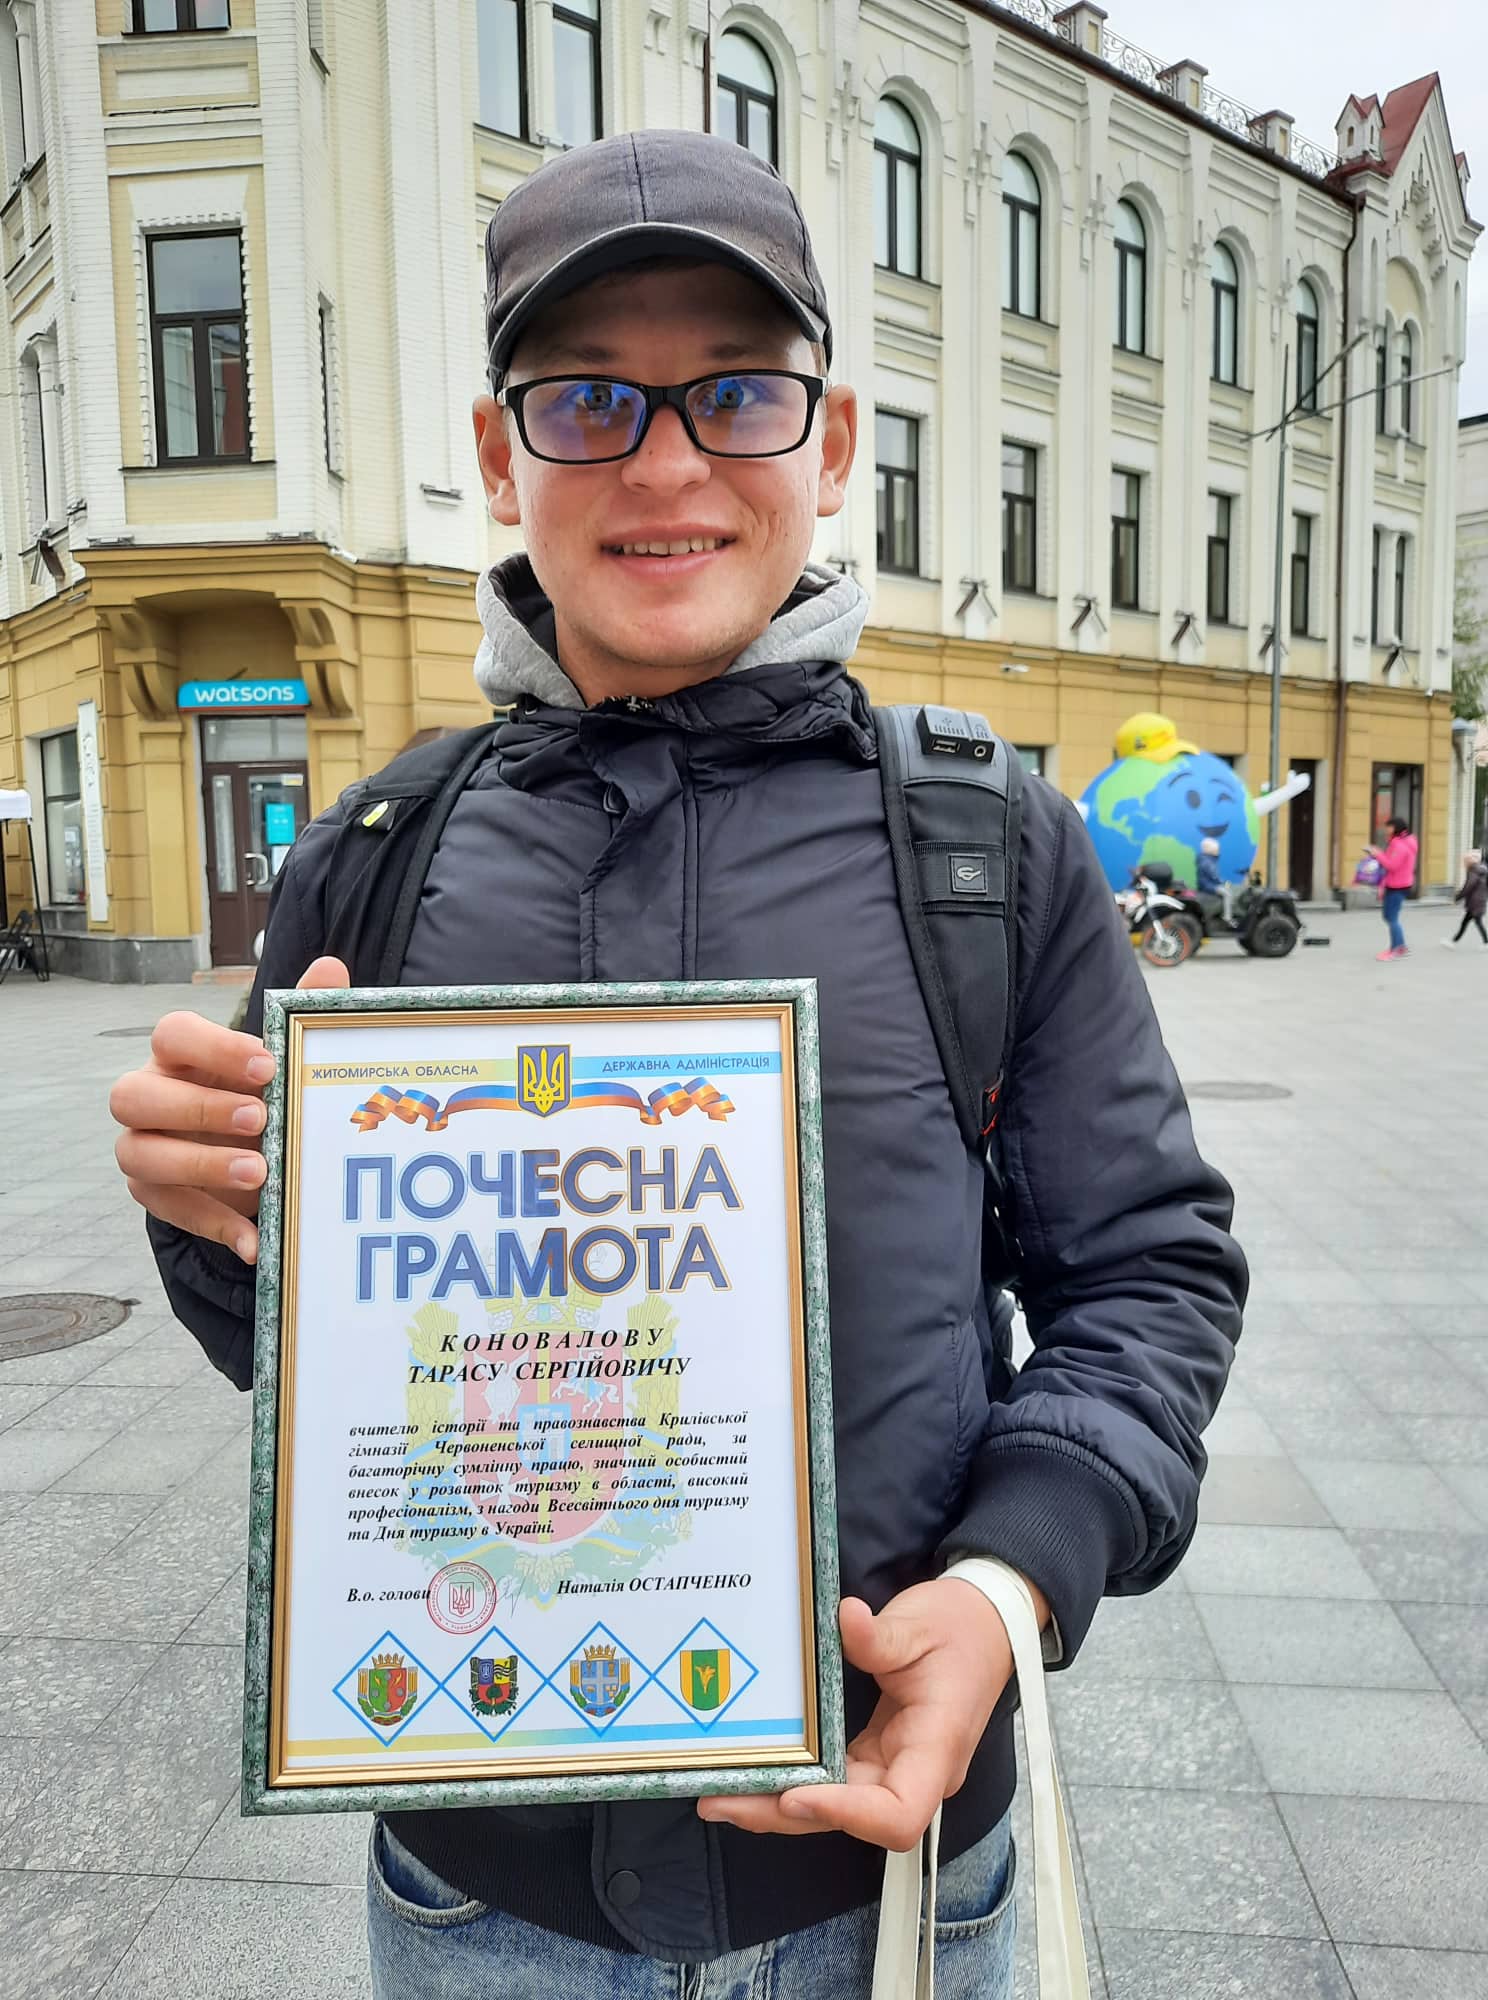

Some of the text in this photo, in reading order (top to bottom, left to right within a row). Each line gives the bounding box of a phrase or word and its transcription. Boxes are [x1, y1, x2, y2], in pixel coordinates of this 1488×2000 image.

[194, 685, 295, 702] watsons
[311, 1064, 479, 1079] ЖИТОМИРСЬКА ОБЛАСНА
[602, 1059, 671, 1073] ДЕРЖАВНА
[342, 1144, 744, 1222] ПОЧЕСНА
[356, 1223, 733, 1303] ГРАМОТА
[440, 1328, 664, 1352] КОНОВАЛОВУ
[408, 1356, 692, 1383] ТАРАСУ СЕРГІЙОВИЧУ
[349, 1411, 748, 1436] вчителю історії та правознавства Крилівської
[349, 1434, 747, 1457] гімназії Червоненської селищної ради, за
[349, 1452, 748, 1479] багаторічну сумлінну працю, значний особистий
[348, 1472, 748, 1499] внесок у розвиток туризму в області, високий
[347, 1495, 750, 1523] професіоналізм, з нагоди Всесвітнього дня туризму
[347, 1518, 555, 1542] та Дня туризму в Україні.
[347, 1588, 432, 1602] В.о. голови
[557, 1573, 752, 1595] Наталія ОСТАПЧЕНКО
